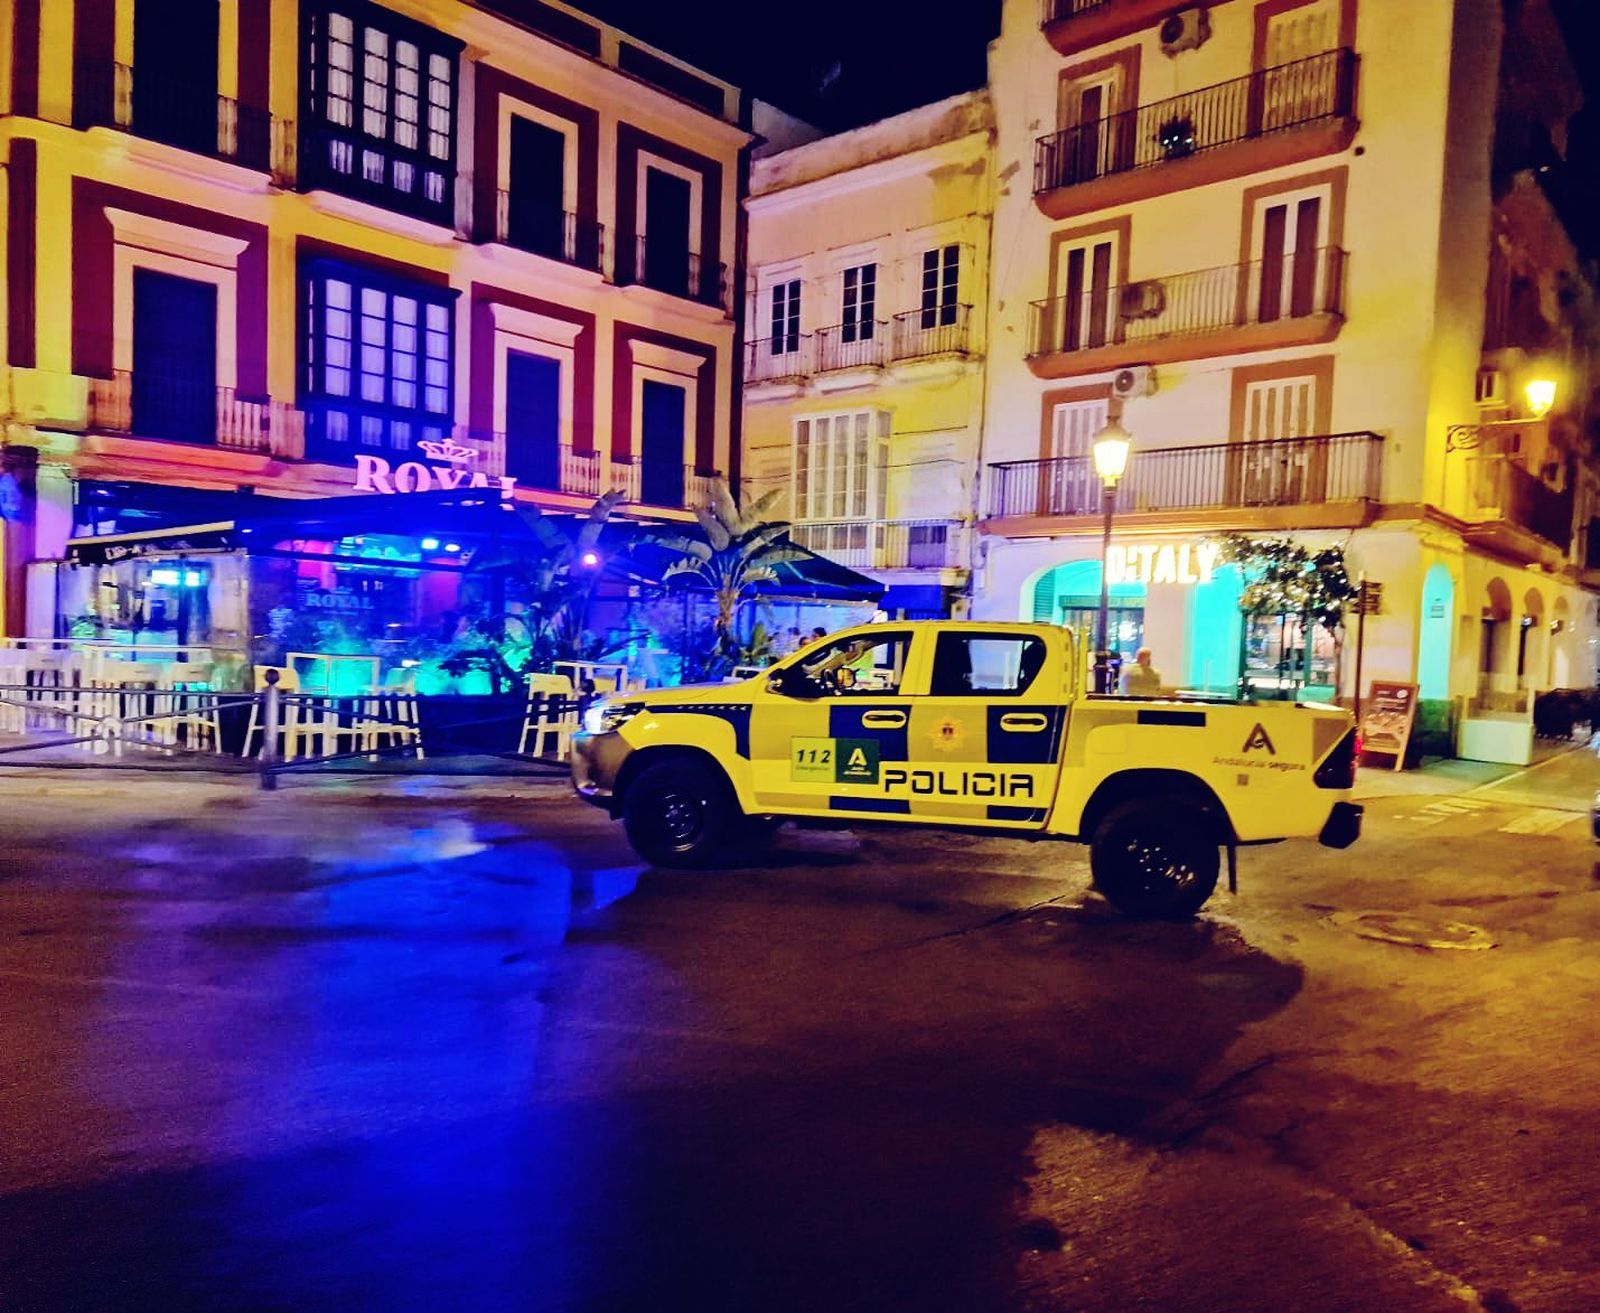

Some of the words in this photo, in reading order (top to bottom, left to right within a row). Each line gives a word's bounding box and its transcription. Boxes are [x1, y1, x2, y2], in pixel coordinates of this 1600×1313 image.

[304, 593, 375, 610] ROYAL
[797, 749, 831, 763] 112
[884, 769, 1034, 798] POLICIA
